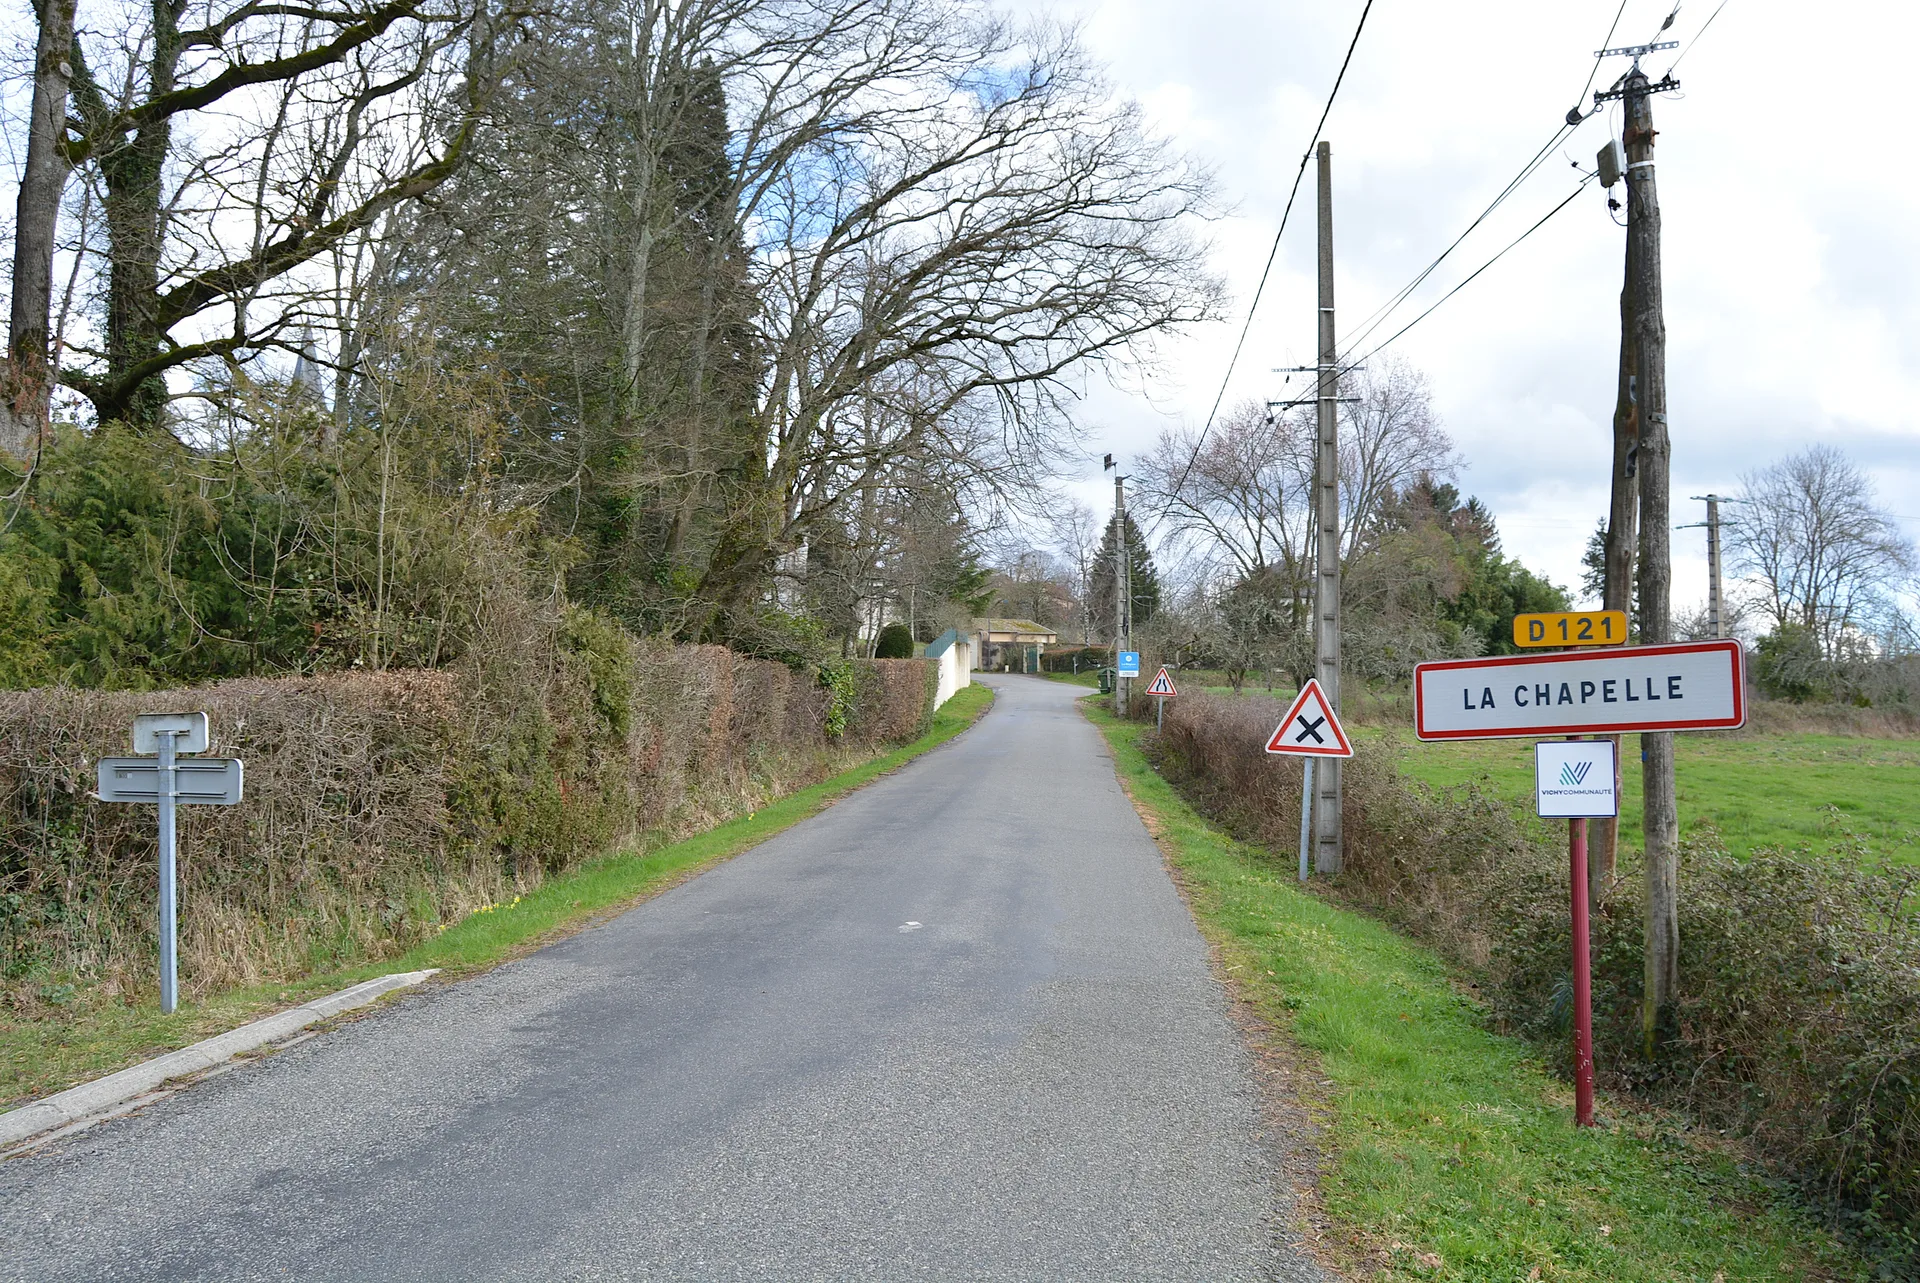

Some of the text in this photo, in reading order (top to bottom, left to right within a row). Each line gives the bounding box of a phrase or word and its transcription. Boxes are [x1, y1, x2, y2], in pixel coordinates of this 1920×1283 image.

[1528, 616, 1612, 642] D 121
[1463, 675, 1684, 711] LA CHAPELLE
